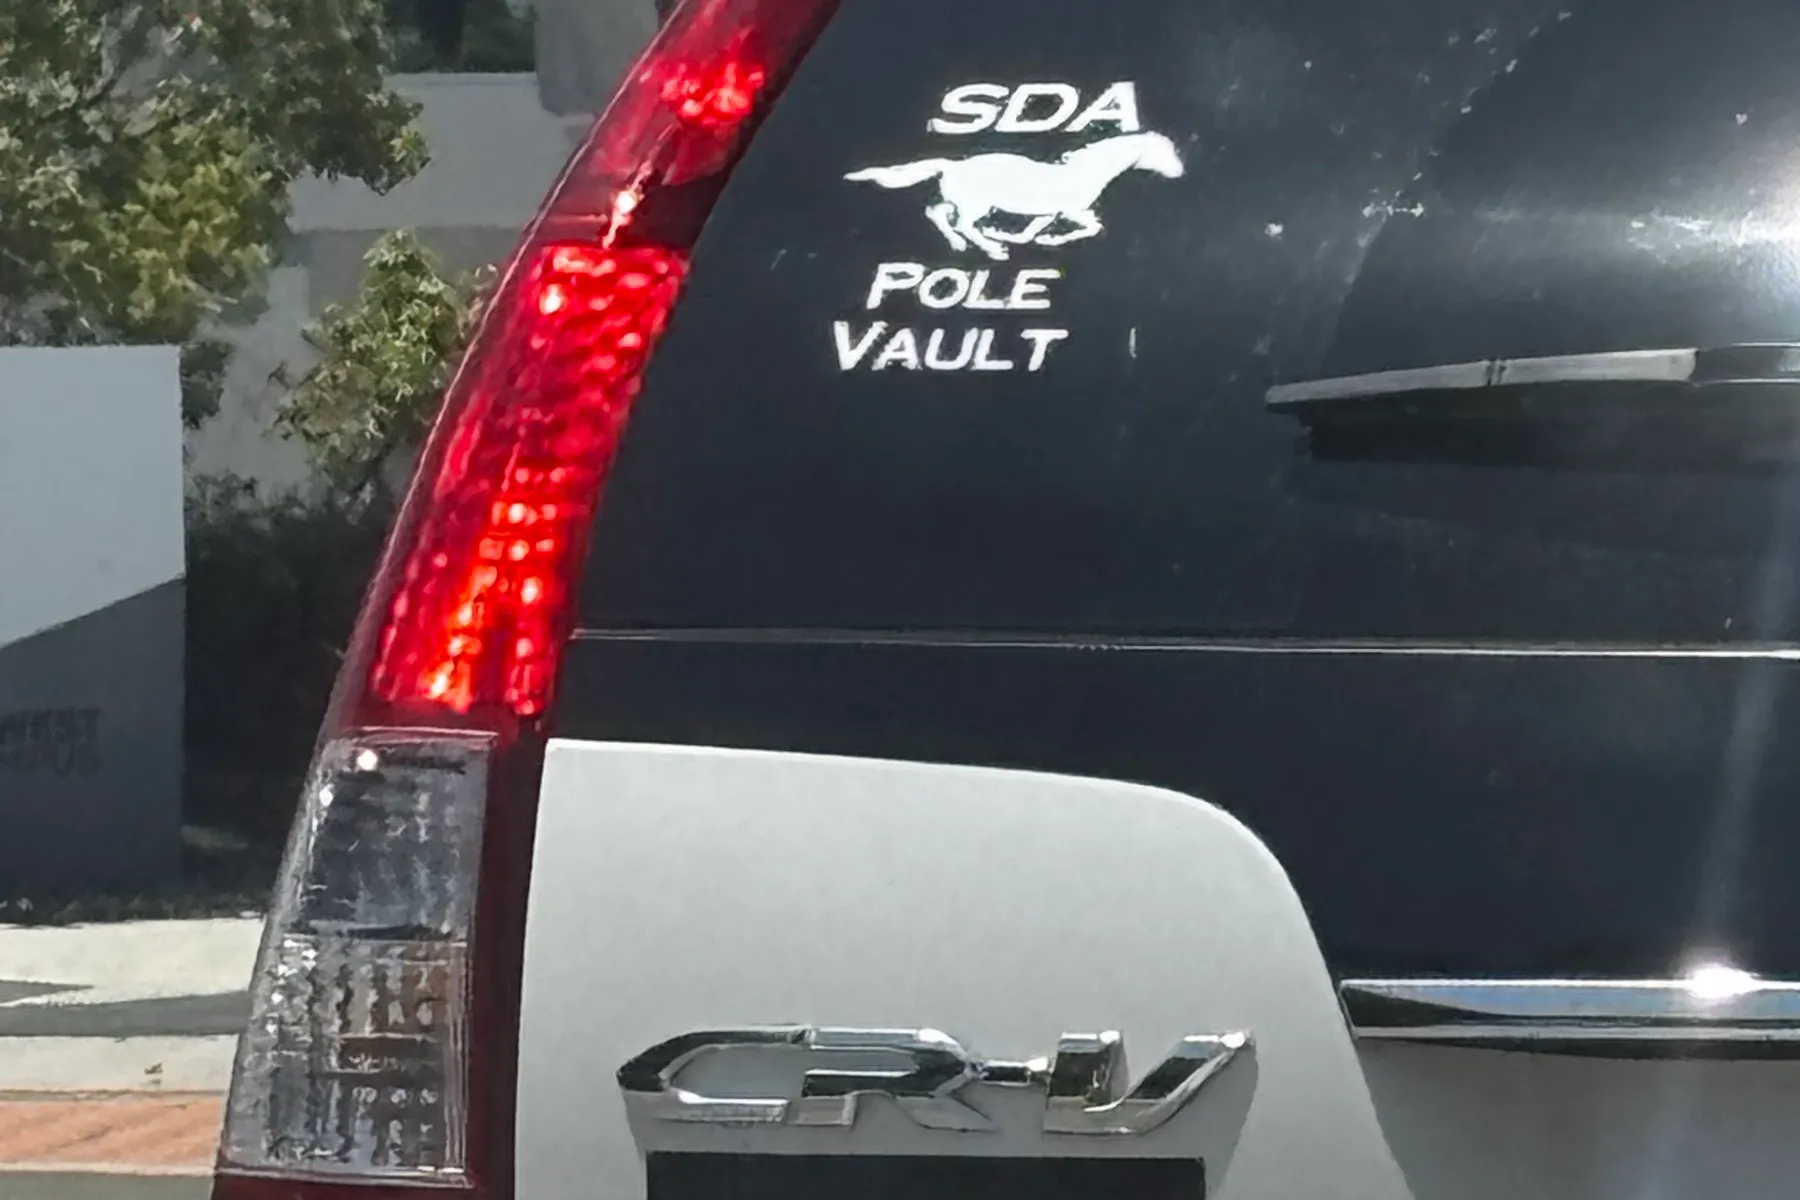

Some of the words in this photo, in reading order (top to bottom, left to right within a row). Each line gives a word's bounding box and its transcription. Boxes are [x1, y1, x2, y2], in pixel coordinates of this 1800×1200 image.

[926, 81, 1140, 134] SDA
[866, 262, 1061, 310] POLE
[833, 320, 1069, 371] VAULT
[617, 1022, 1255, 1135] CR-V
